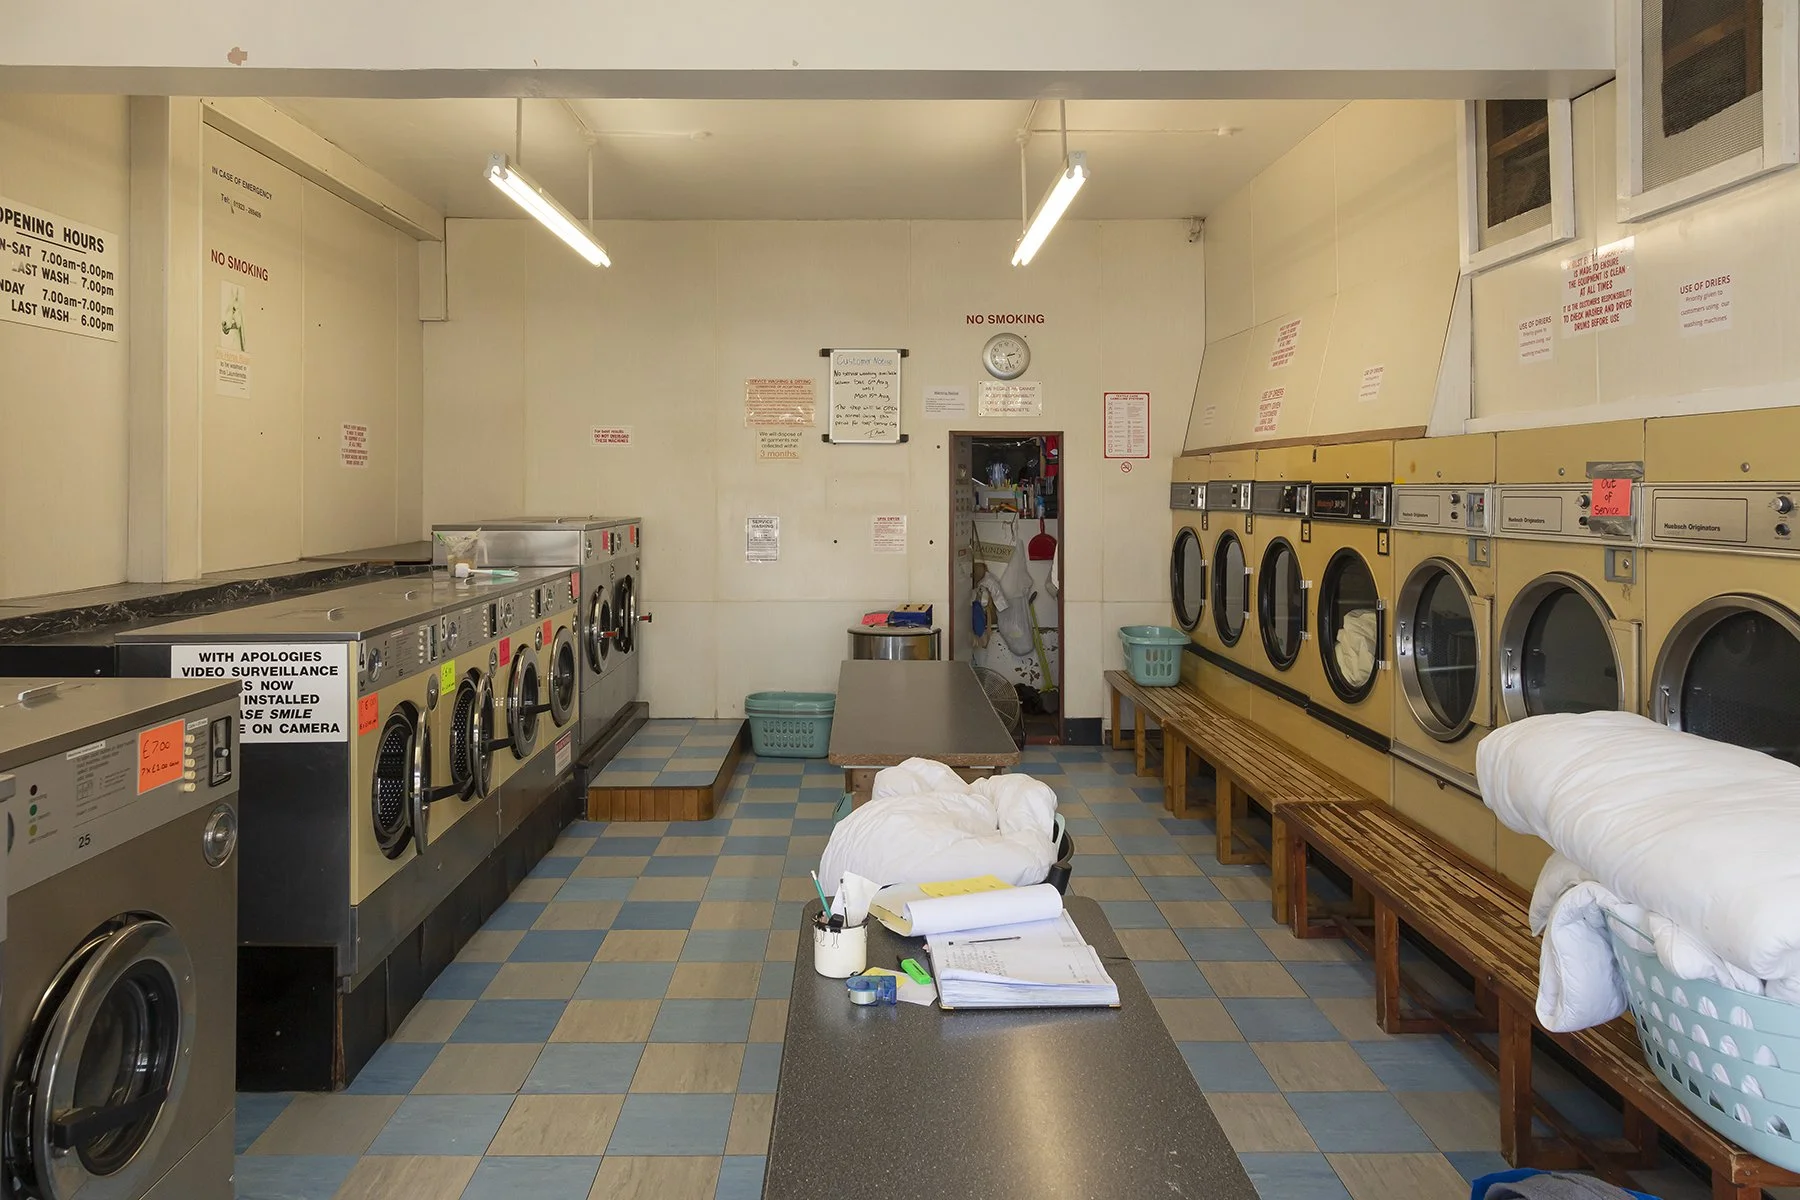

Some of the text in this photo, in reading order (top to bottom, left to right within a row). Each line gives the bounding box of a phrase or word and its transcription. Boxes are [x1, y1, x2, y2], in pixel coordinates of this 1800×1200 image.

[212, 166, 272, 200] IN CASE OF EMERGENCY
[64, 227, 104, 253] HOURS
[41, 250, 114, 280] 7.00am-8.00pm
[211, 248, 268, 282] NO SMOKING
[1580, 265, 1592, 276] MADE
[1592, 263, 1598, 272] TO
[1600, 256, 1619, 270] ENSURE
[42, 267, 70, 285] WASH
[81, 277, 114, 296] 7.00pm
[1568, 265, 1626, 289] THE EQUIPMENT IS CLEAN
[1680, 274, 1730, 294] USE OF DRIERS
[1580, 280, 1612, 297] AT ALL TIMES
[1601, 288, 1632, 302] RESPONSIBILITY
[42, 289, 114, 316] 7.00am-7.00pm
[12, 299, 114, 332] LAST WASH 6.00pm
[1564, 299, 1632, 324] TO CHECK WASHER AND DRYER
[1680, 306, 1705, 316] customers
[966, 314, 1045, 324] NO SMOKING
[1519, 316, 1552, 330] USE OF DRIERS
[1574, 313, 1620, 332] DRUMS BEFORE USE
[1684, 314, 1728, 328] washing machines
[1601, 478, 1616, 489] Out
[1604, 492, 1613, 502] of
[1594, 505, 1620, 515] Service
[1688, 524, 1721, 532] Originators
[199, 652, 322, 662] WITH APOLOGIES
[359, 642, 365, 668] 4
[182, 666, 338, 677] VIDEO SURVEILLANCE
[261, 680, 294, 690] NOW
[244, 694, 320, 705] INSTALLED
[270, 709, 312, 719] SMILE
[252, 724, 272, 733] ON
[280, 723, 340, 734] CAMERA
[79, 834, 91, 848] 25
